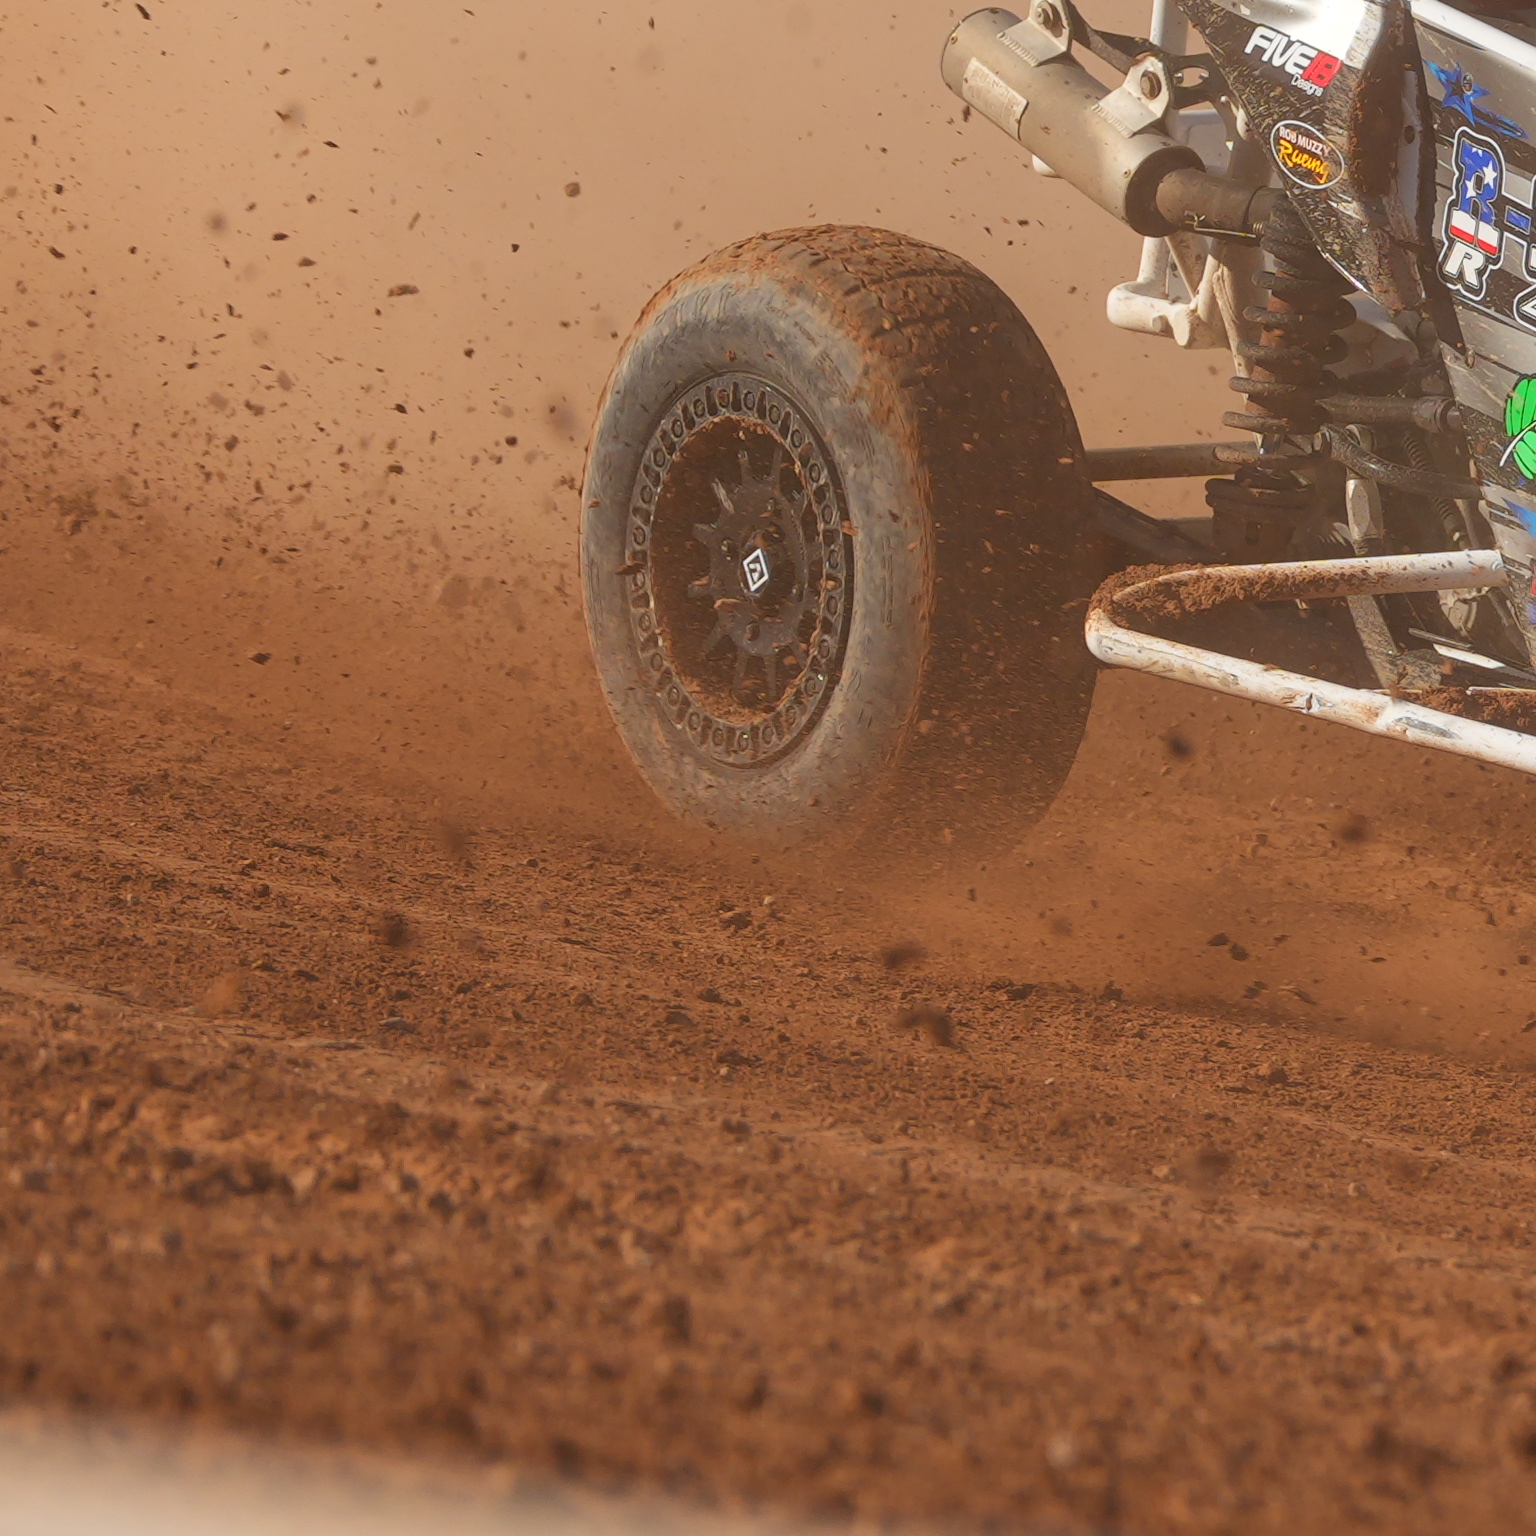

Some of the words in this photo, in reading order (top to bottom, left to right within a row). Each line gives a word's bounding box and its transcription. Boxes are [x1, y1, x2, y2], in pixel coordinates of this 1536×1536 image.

[1290, 72, 1324, 97] Designs
[1278, 125, 1297, 145] ROB
[1297, 134, 1332, 157] MUZZY
